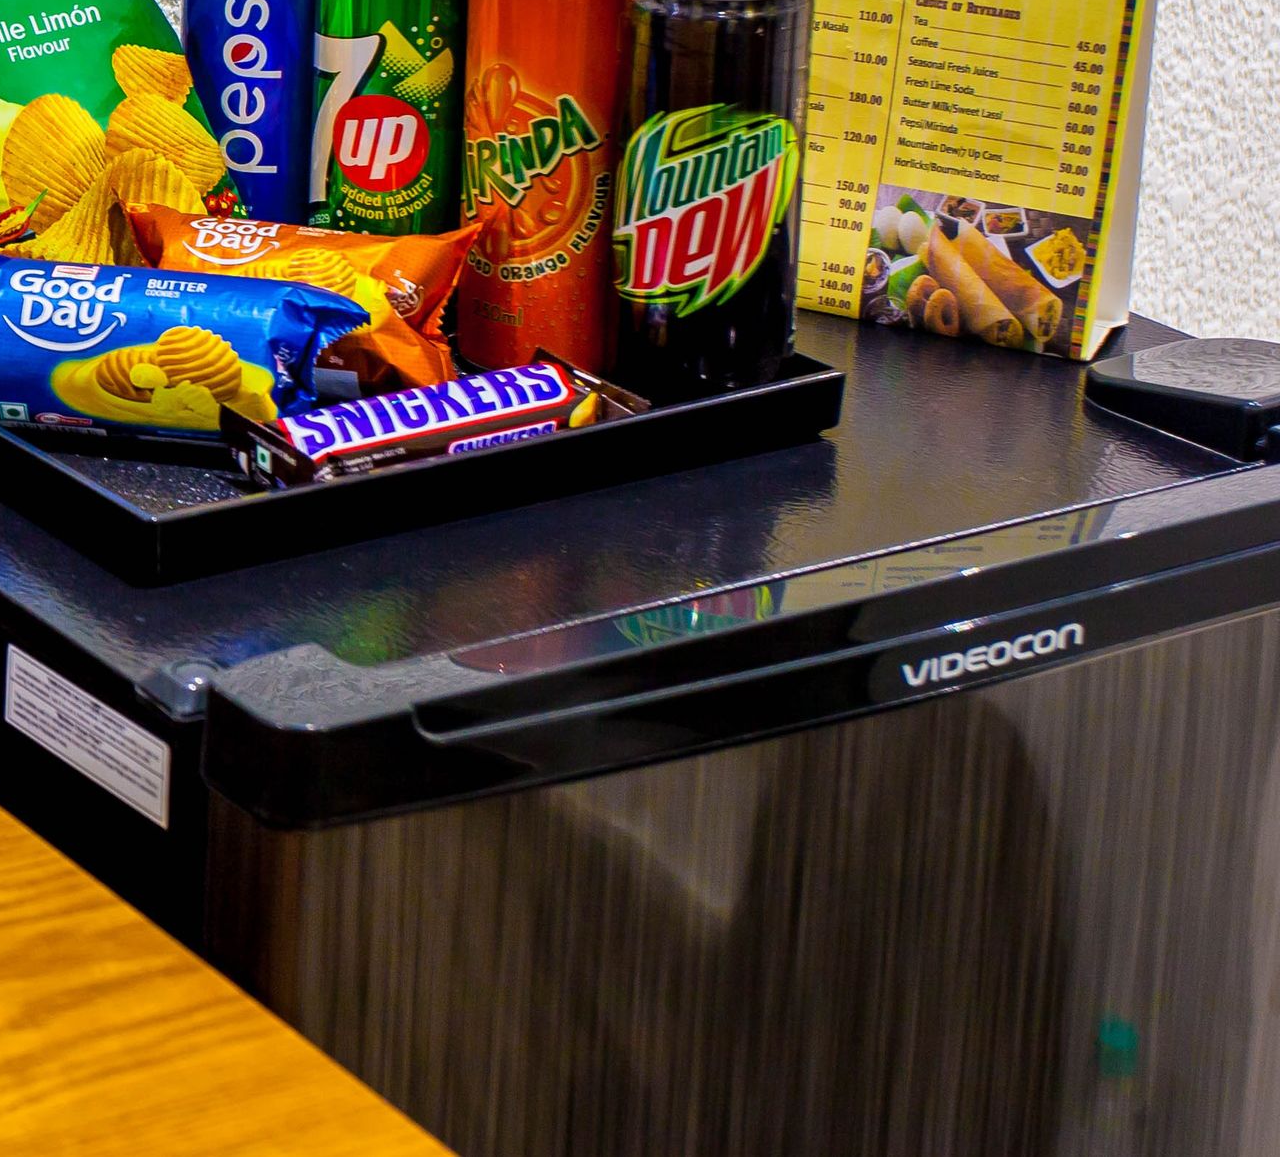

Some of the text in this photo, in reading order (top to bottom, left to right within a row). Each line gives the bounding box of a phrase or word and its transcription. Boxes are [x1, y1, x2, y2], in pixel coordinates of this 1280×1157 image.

[28, 4, 102, 35] Limón
[822, 21, 849, 33] Masala
[859, 10, 893, 24] 110.00
[7, 37, 71, 62] Flavour
[913, 16, 1106, 55] Tea 45.00
[853, 52, 888, 66] 110.00
[910, 36, 1104, 75] Coffee 45.00
[905, 76, 929, 88] Fresh
[930, 80, 951, 92] Lime
[952, 84, 975, 95] Soda
[907, 56, 1101, 95] Seasonal Fresh Juices 90.00
[903, 96, 930, 108] Butter
[981, 109, 1004, 120] Lassi
[808, 142, 825, 153] Rice
[900, 116, 1092, 156] Pepsi/Mirinda 50.00
[897, 137, 938, 151] Mountain
[968, 149, 981, 160] Up
[982, 150, 1004, 162] Cans
[1059, 163, 1089, 177] 50.00
[341, 173, 434, 207] added natural
[342, 190, 435, 220] lemon flavour
[1055, 183, 1086, 197] 50.00
[190, 217, 280, 238] Good
[195, 230, 264, 254] Day
[9, 268, 126, 304] Good
[146, 278, 208, 294] BUTTER
[20, 294, 105, 336] Day
[295, 362, 562, 456] SNICKERS
[900, 622, 1085, 687] VIDEOCON
